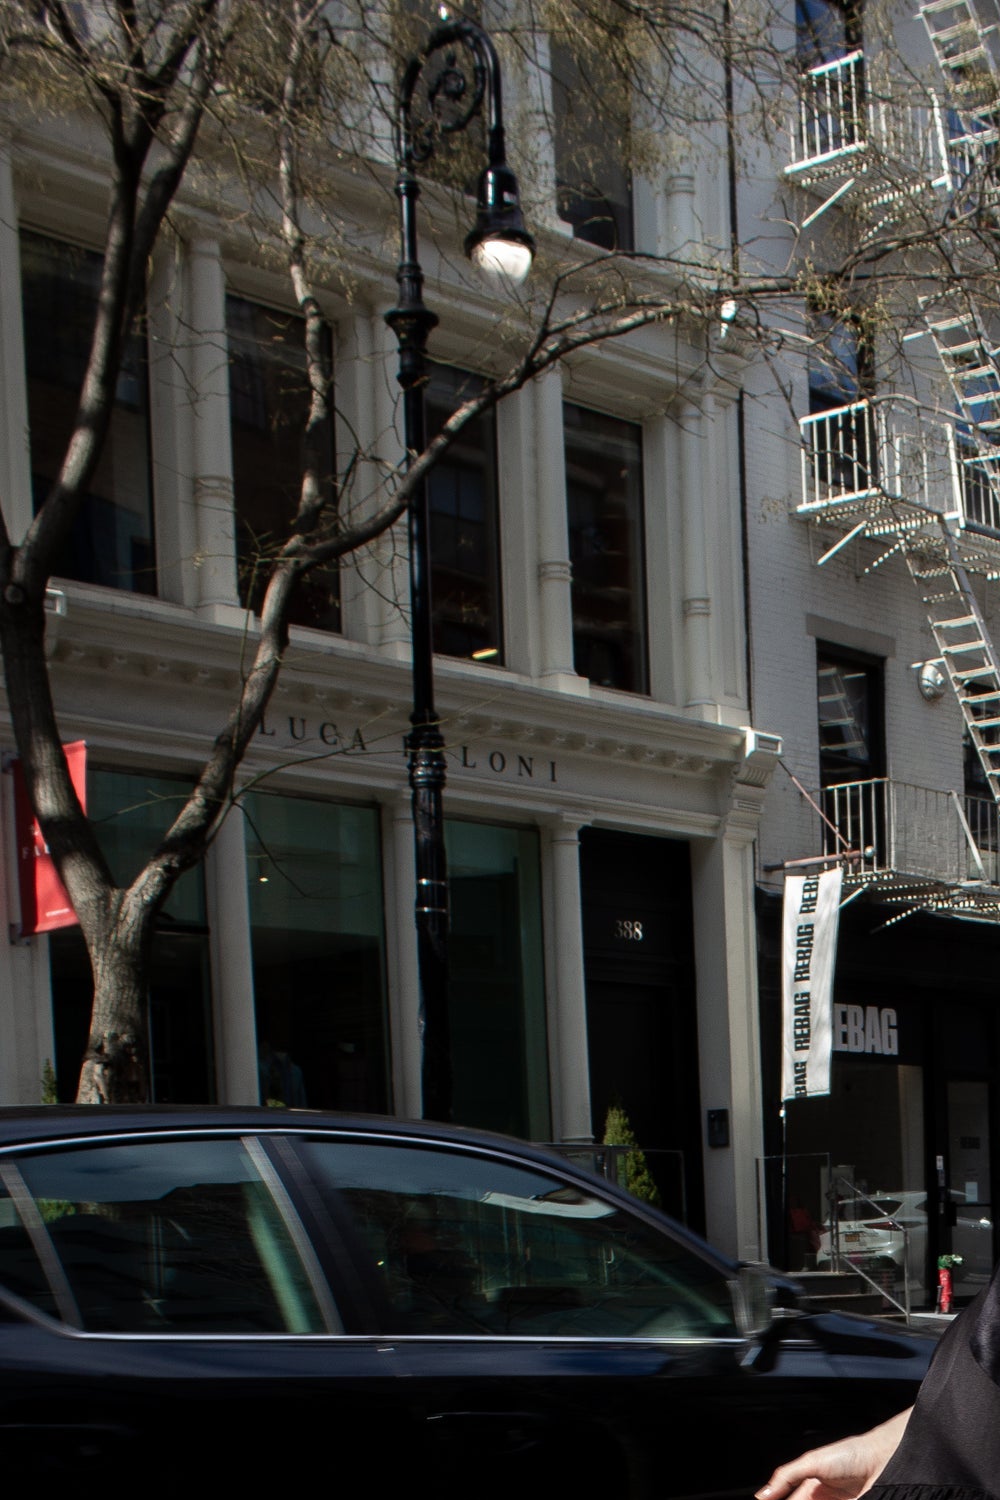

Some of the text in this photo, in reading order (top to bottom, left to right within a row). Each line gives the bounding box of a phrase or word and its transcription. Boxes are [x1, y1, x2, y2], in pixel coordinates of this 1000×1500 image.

[259, 715, 367, 751] LUCA
[614, 920, 643, 941] 388
[794, 923, 814, 982] REBAG
[794, 992, 811, 1051] REBAG
[832, 1003, 899, 1056] EBAG
